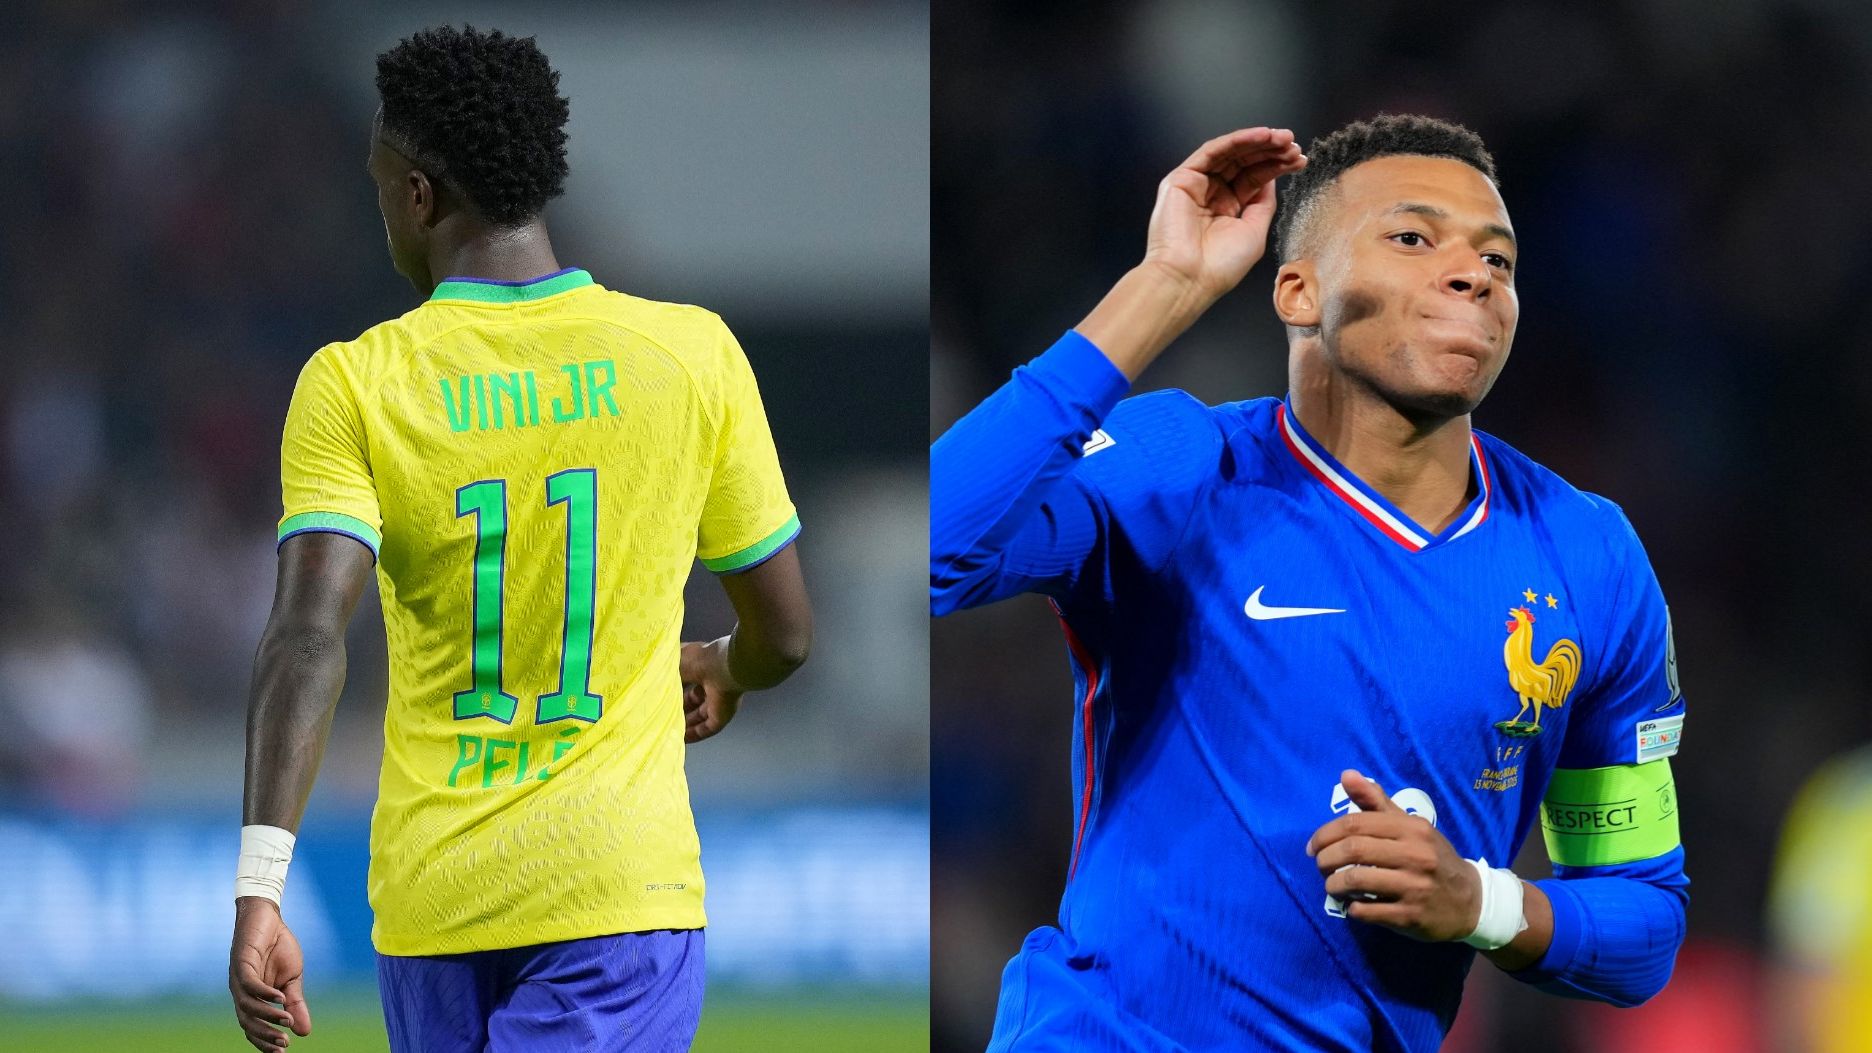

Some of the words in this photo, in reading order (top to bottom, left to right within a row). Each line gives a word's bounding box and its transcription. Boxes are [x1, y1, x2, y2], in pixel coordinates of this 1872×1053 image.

[439, 371, 540, 432] VINI
[552, 360, 620, 423] JR
[452, 468, 603, 725] 11
[1639, 723, 1656, 732] UEFA
[1546, 806, 1637, 829] RESPECT
